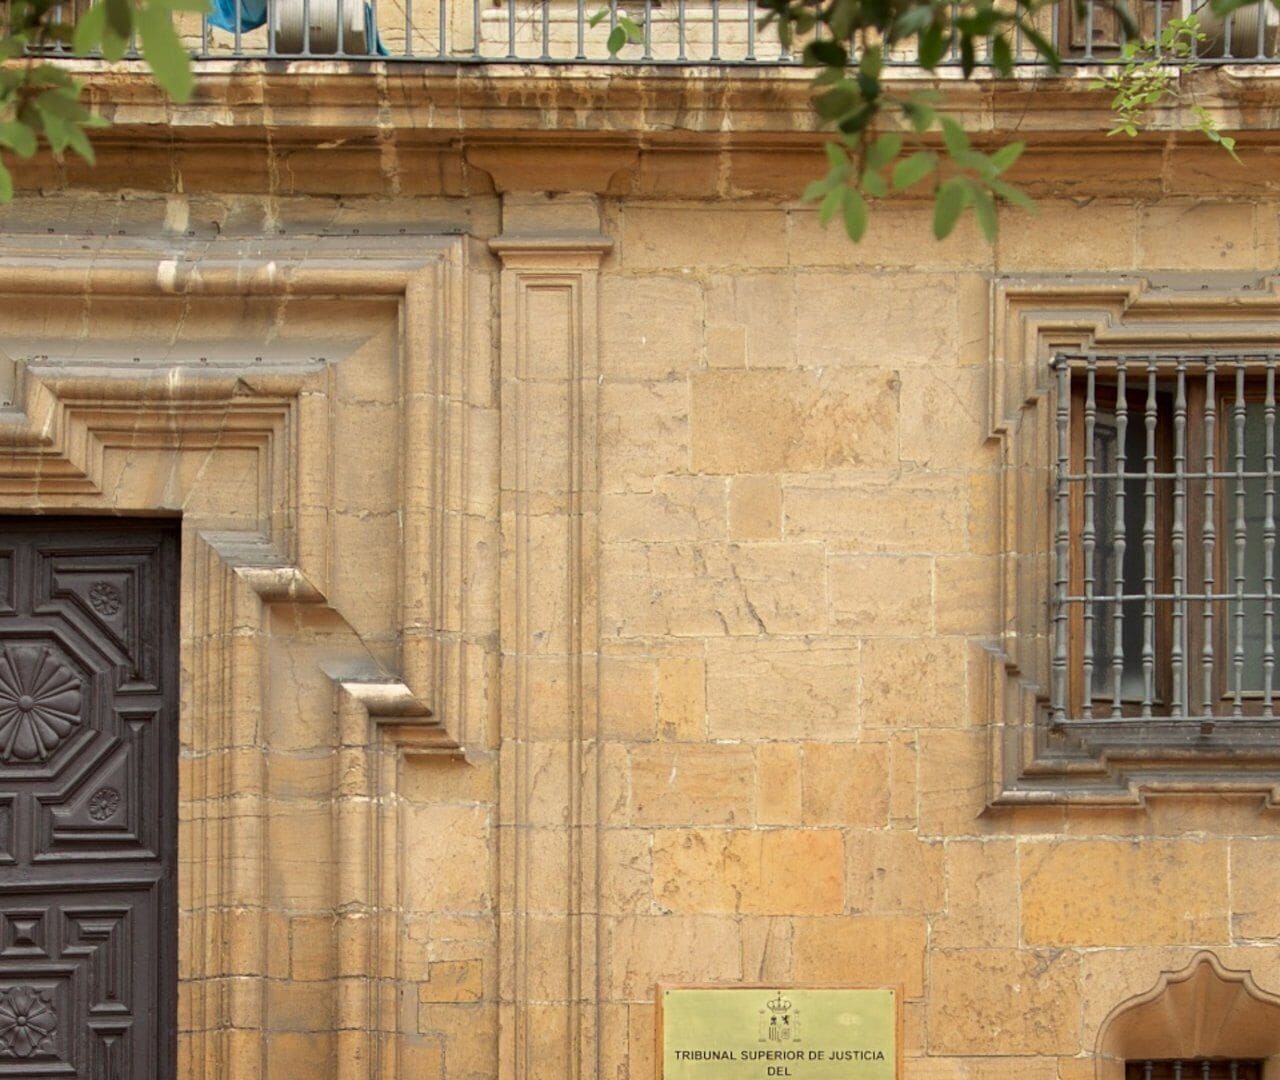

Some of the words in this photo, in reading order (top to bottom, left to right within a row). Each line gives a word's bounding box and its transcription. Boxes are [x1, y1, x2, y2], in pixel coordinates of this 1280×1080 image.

[675, 1050, 737, 1061] TRIBUNAL
[740, 1050, 804, 1061] SUPERIOR
[808, 1050, 825, 1061] DE
[828, 1050, 885, 1061] JUSTICIA
[767, 1066, 792, 1076] DEL
